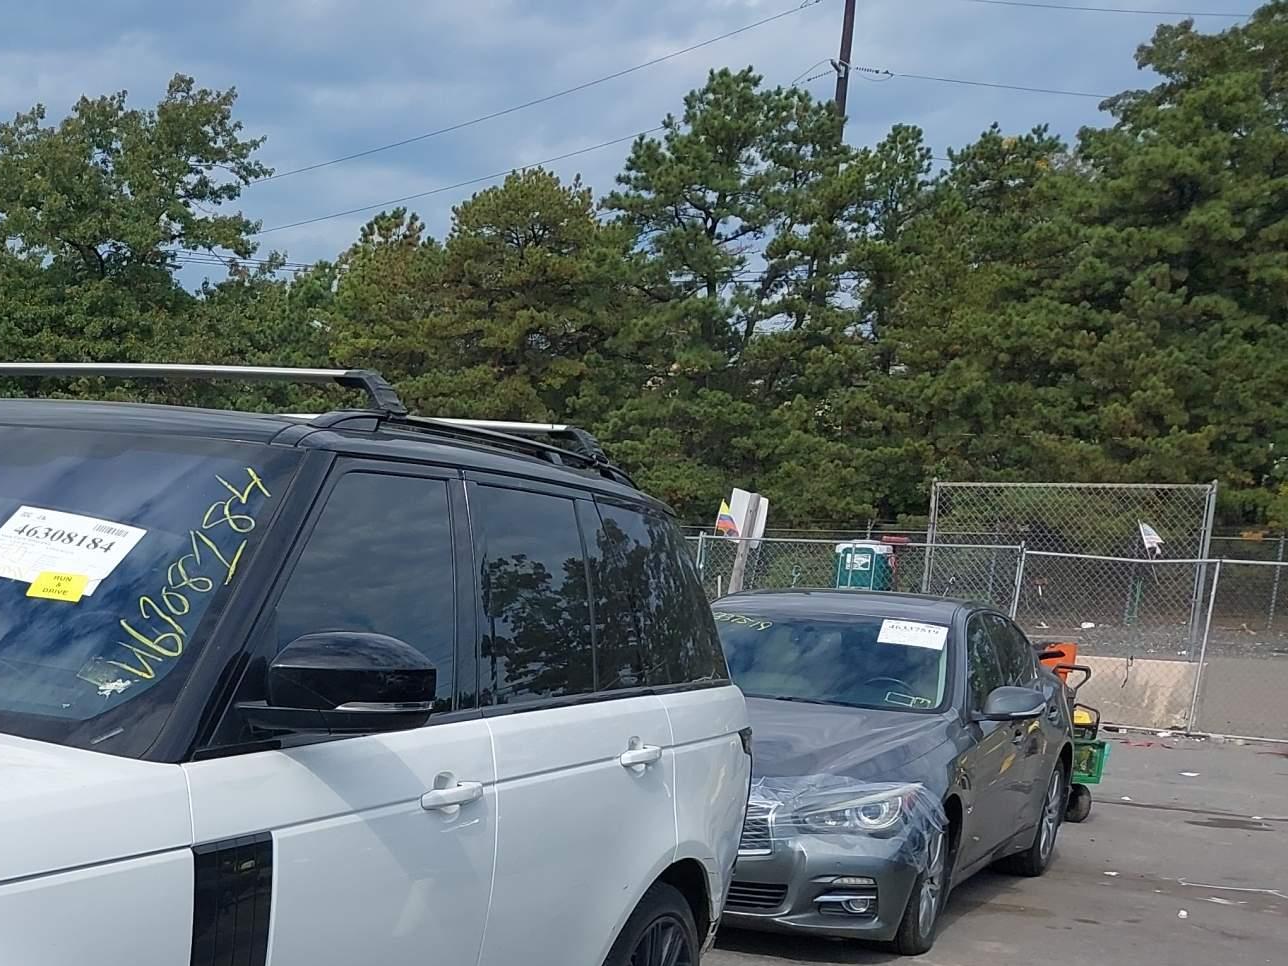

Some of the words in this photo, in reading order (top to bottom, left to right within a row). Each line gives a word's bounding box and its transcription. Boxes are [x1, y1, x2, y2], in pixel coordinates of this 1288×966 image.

[13, 523, 117, 554] 46308184
[52, 575, 73, 583] RUN
[42, 587, 70, 596] DRIVE
